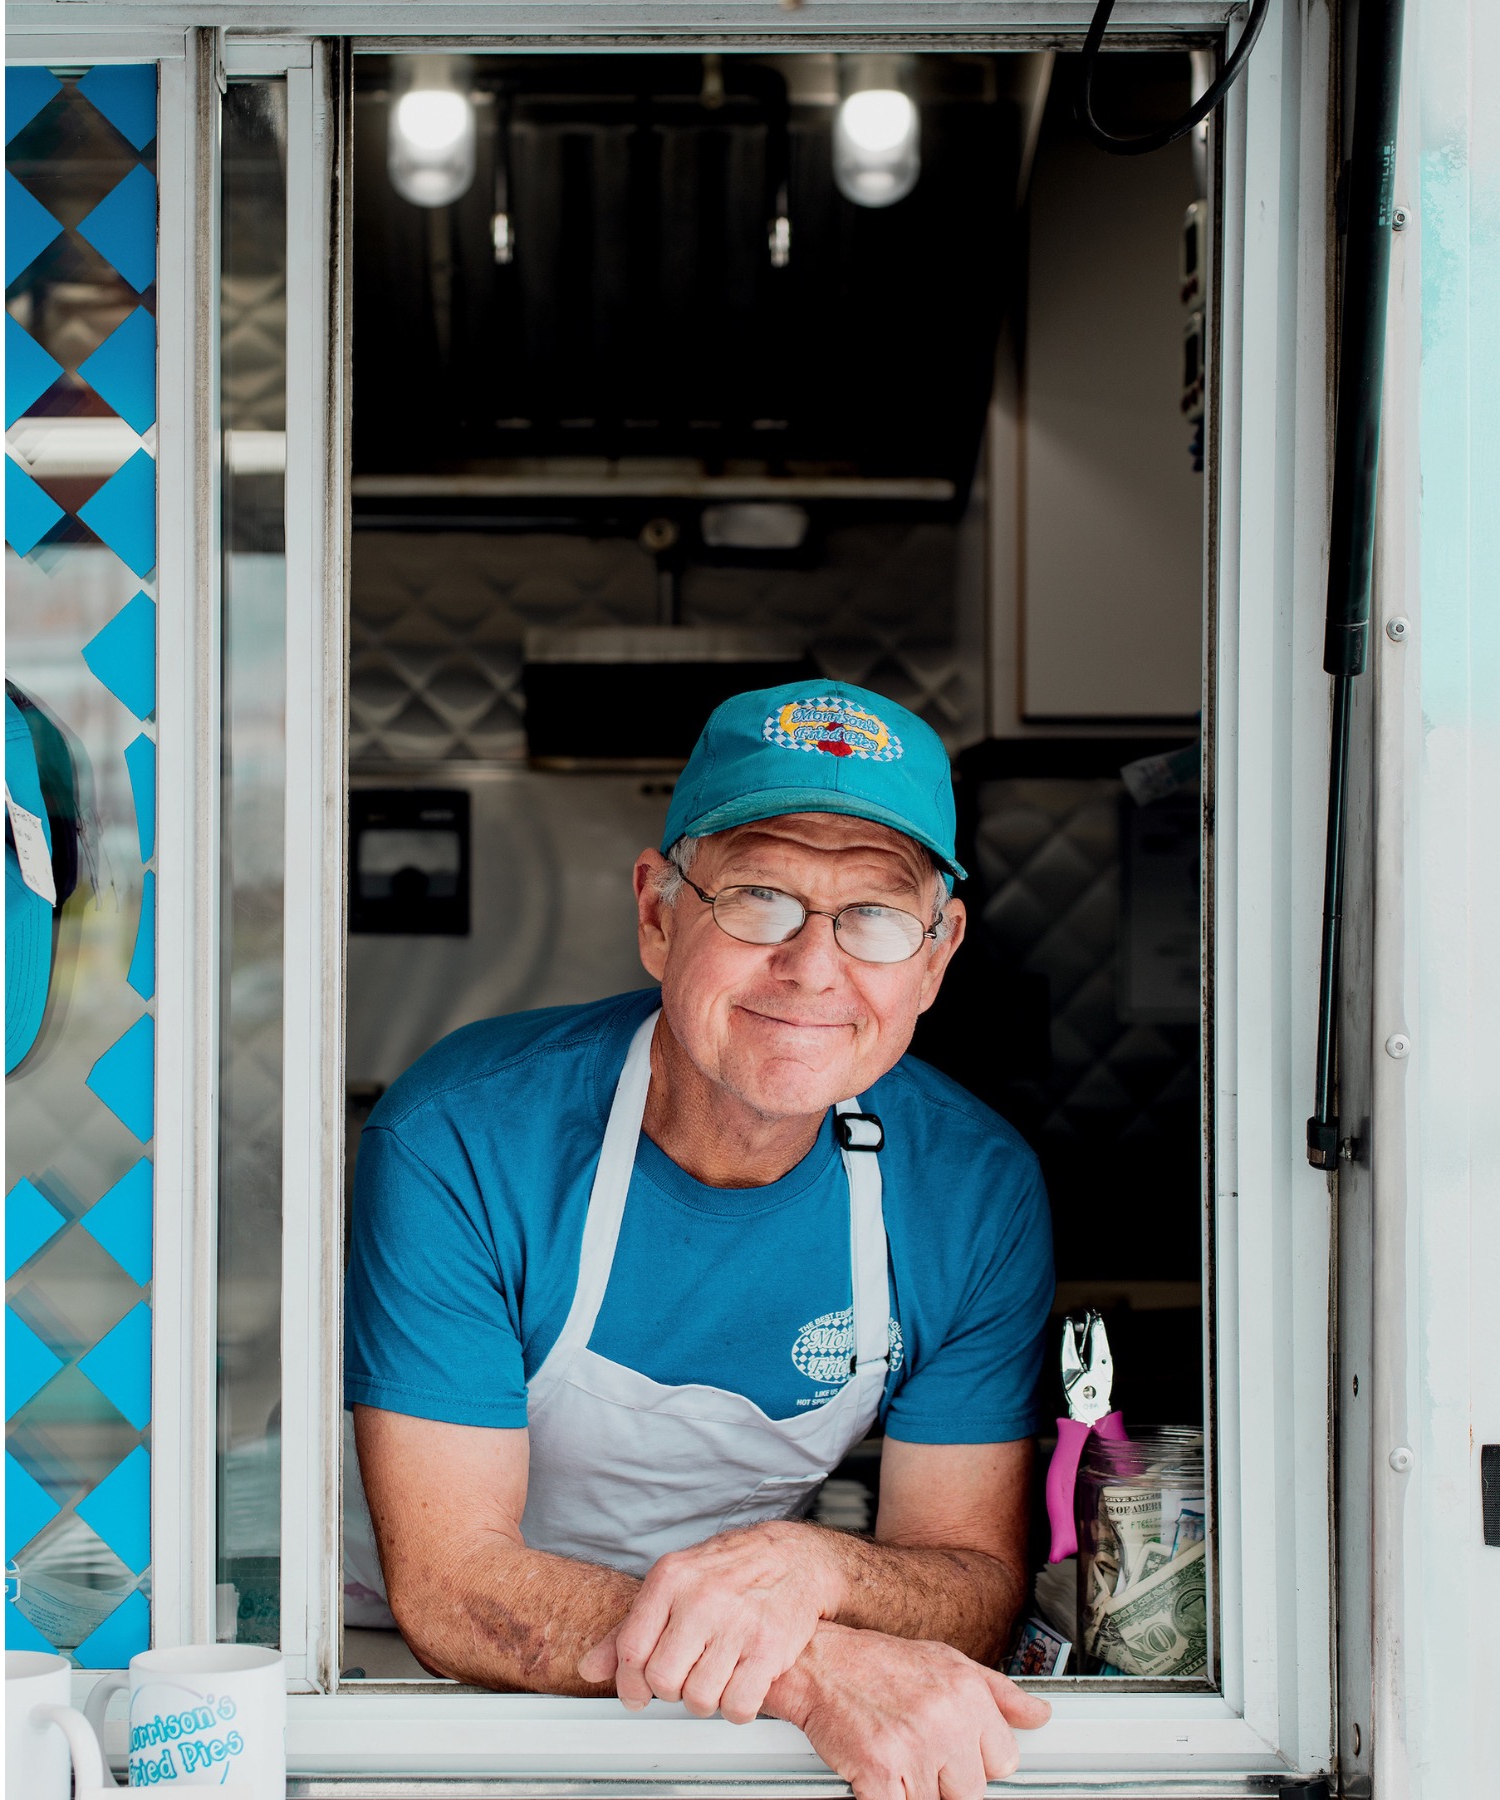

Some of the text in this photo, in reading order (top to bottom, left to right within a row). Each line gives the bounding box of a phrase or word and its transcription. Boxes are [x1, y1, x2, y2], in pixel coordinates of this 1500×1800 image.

[792, 707, 879, 734] Morrison's
[794, 725, 878, 751] Fried Pies
[798, 1321, 814, 1334] THE
[814, 1312, 834, 1325] BEST
[796, 1398, 811, 1406] HOT
[129, 1694, 237, 1754] orrison's
[177, 1730, 244, 1774] Pies
